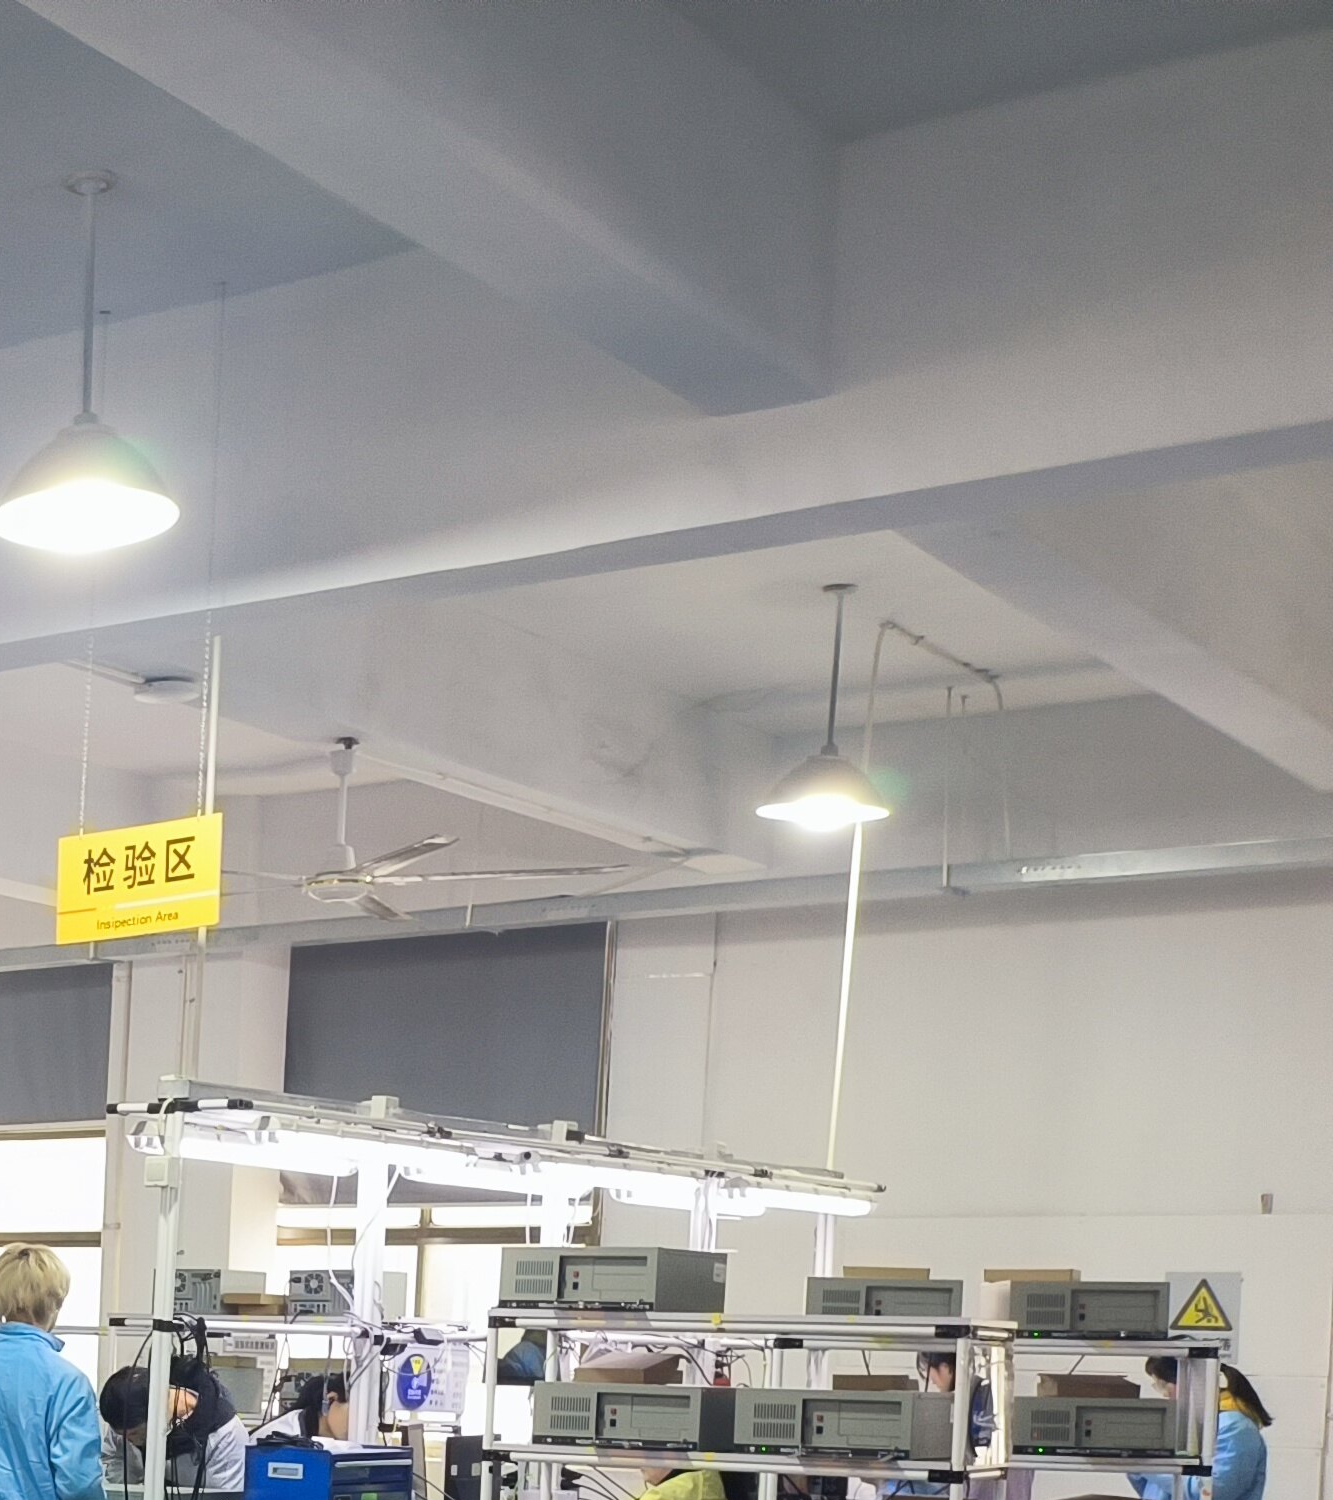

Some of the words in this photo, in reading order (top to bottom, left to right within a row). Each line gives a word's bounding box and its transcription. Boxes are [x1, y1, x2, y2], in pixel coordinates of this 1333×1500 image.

[83, 835, 196, 895] 检验区
[155, 910, 179, 922] Area
